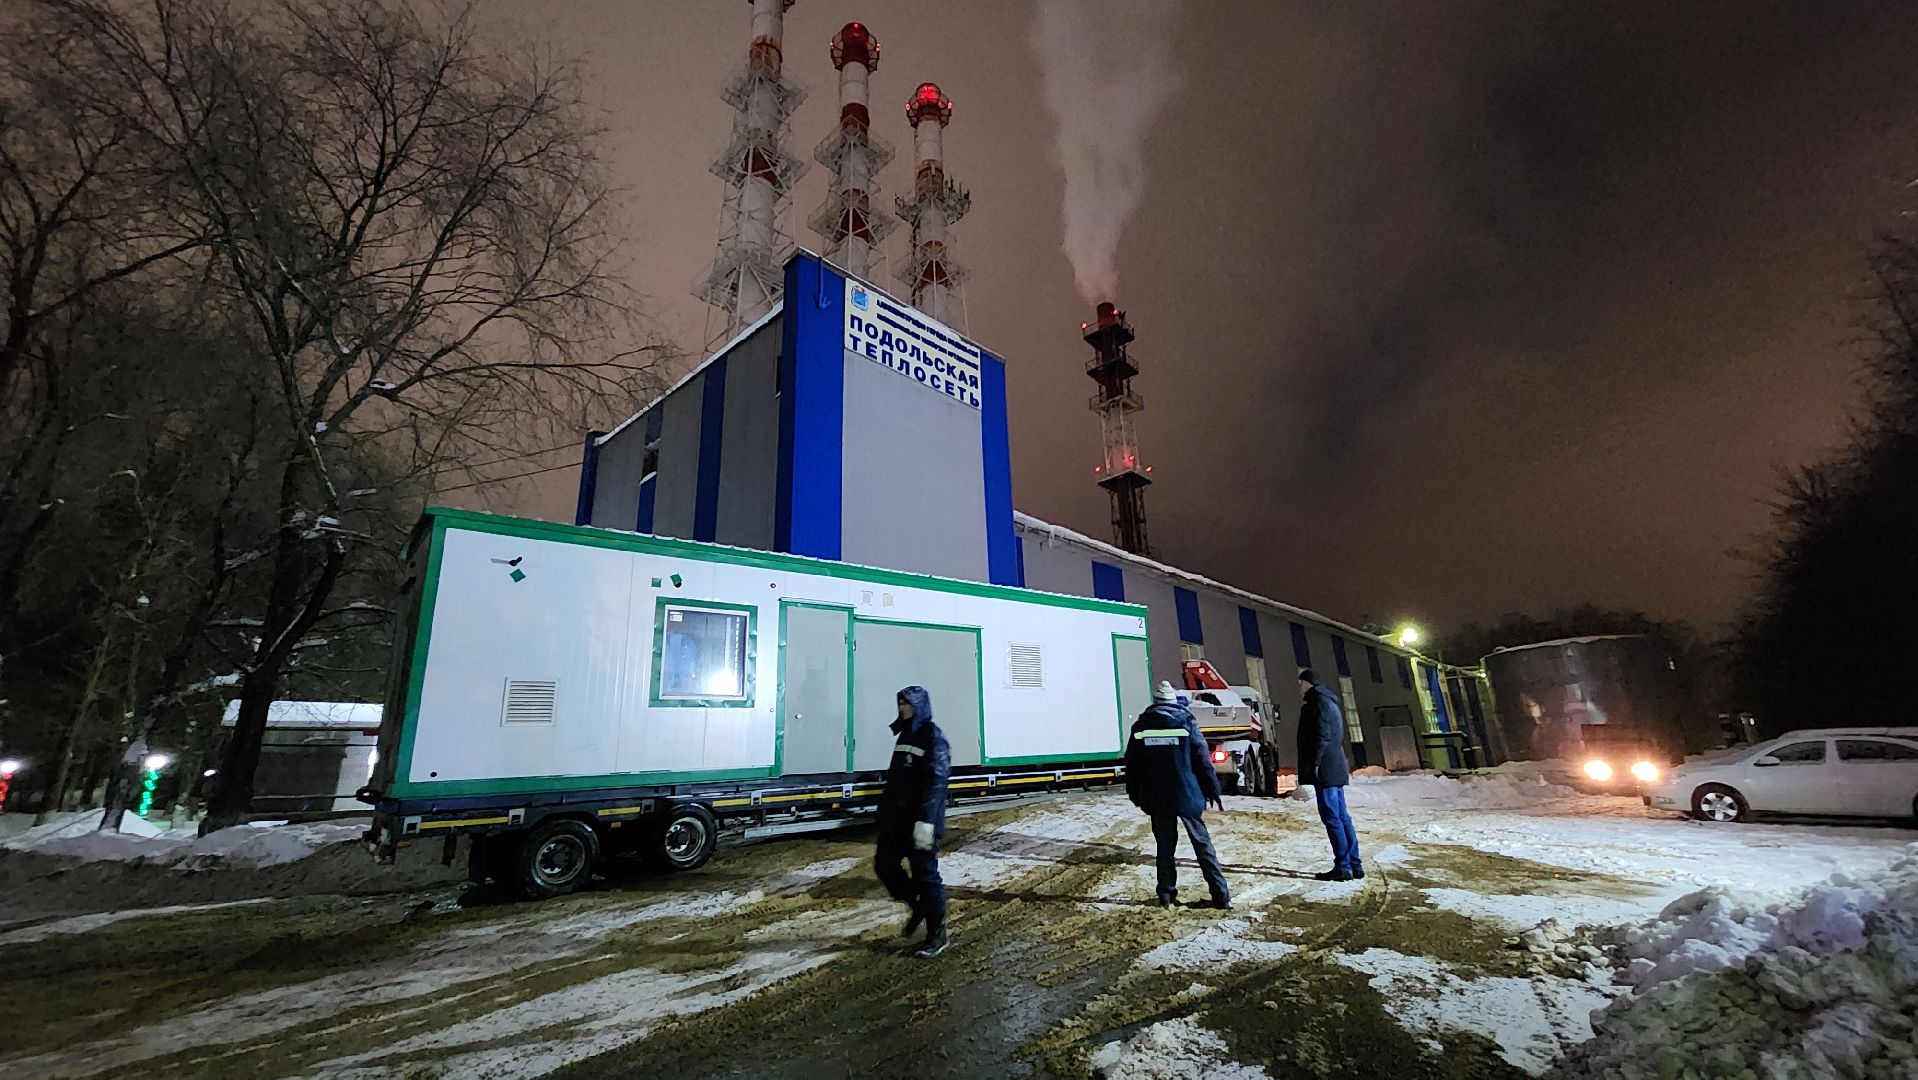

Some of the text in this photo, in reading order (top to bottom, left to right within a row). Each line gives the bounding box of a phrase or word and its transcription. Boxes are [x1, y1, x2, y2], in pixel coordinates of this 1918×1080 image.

[848, 333, 980, 408] ТЕПЛОСЕТЬ
[850, 313, 979, 390] ПОДОЛЬСКАЯ
[1137, 617, 1144, 629] 2
